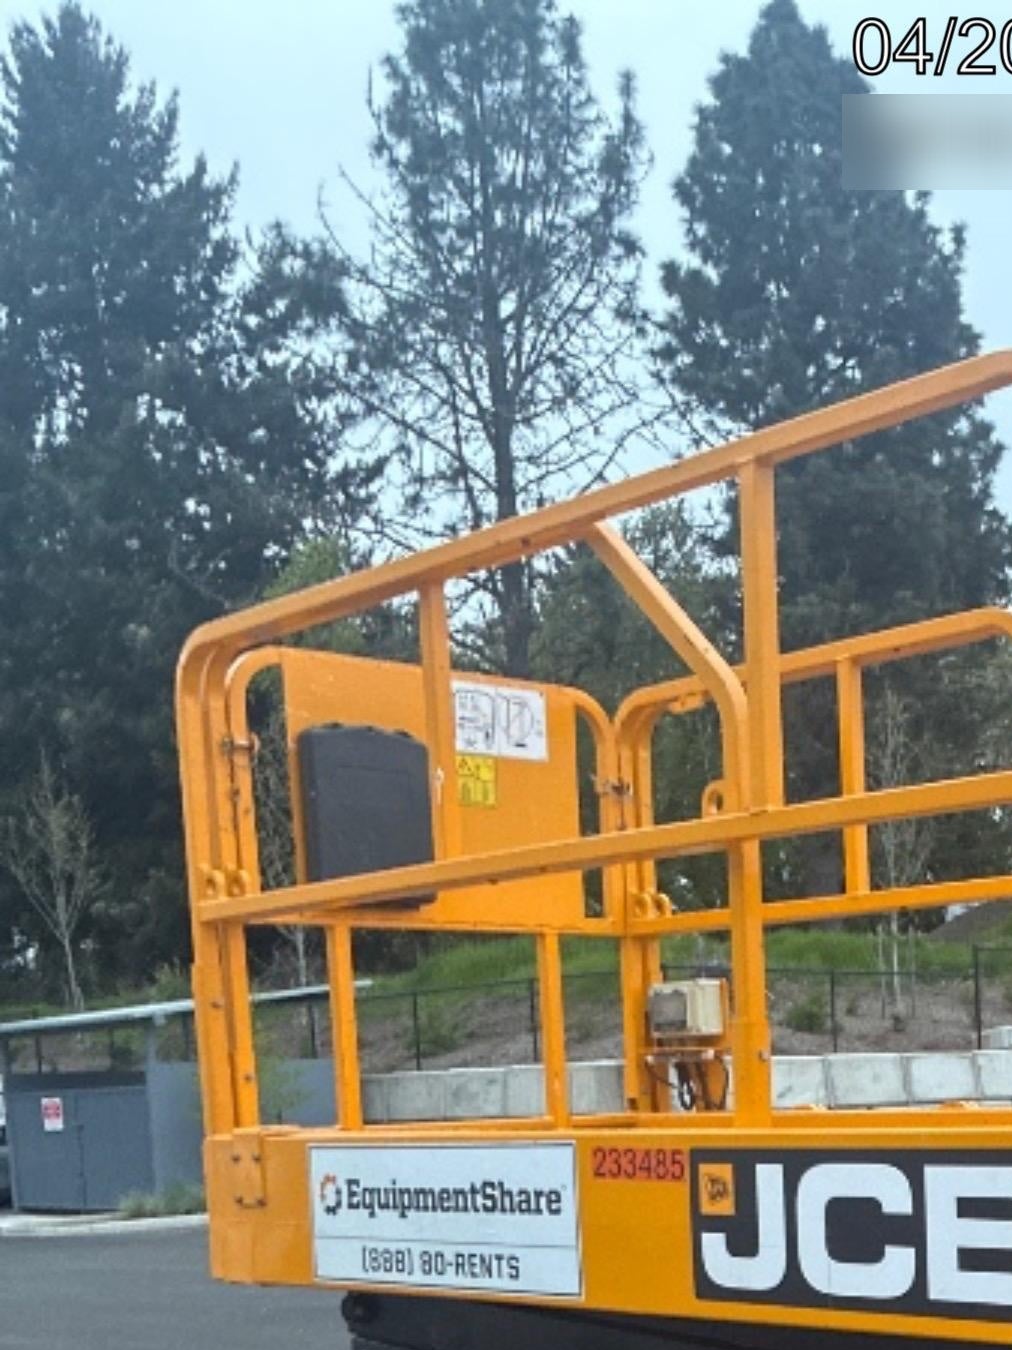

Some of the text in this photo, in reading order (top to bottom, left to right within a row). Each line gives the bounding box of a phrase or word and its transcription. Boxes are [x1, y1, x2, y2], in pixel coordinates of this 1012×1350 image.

[592, 1148, 685, 1179] 233485
[344, 1178, 563, 1218] EquipmentShare
[361, 1245, 521, 1281] (888) 80-RENTS
